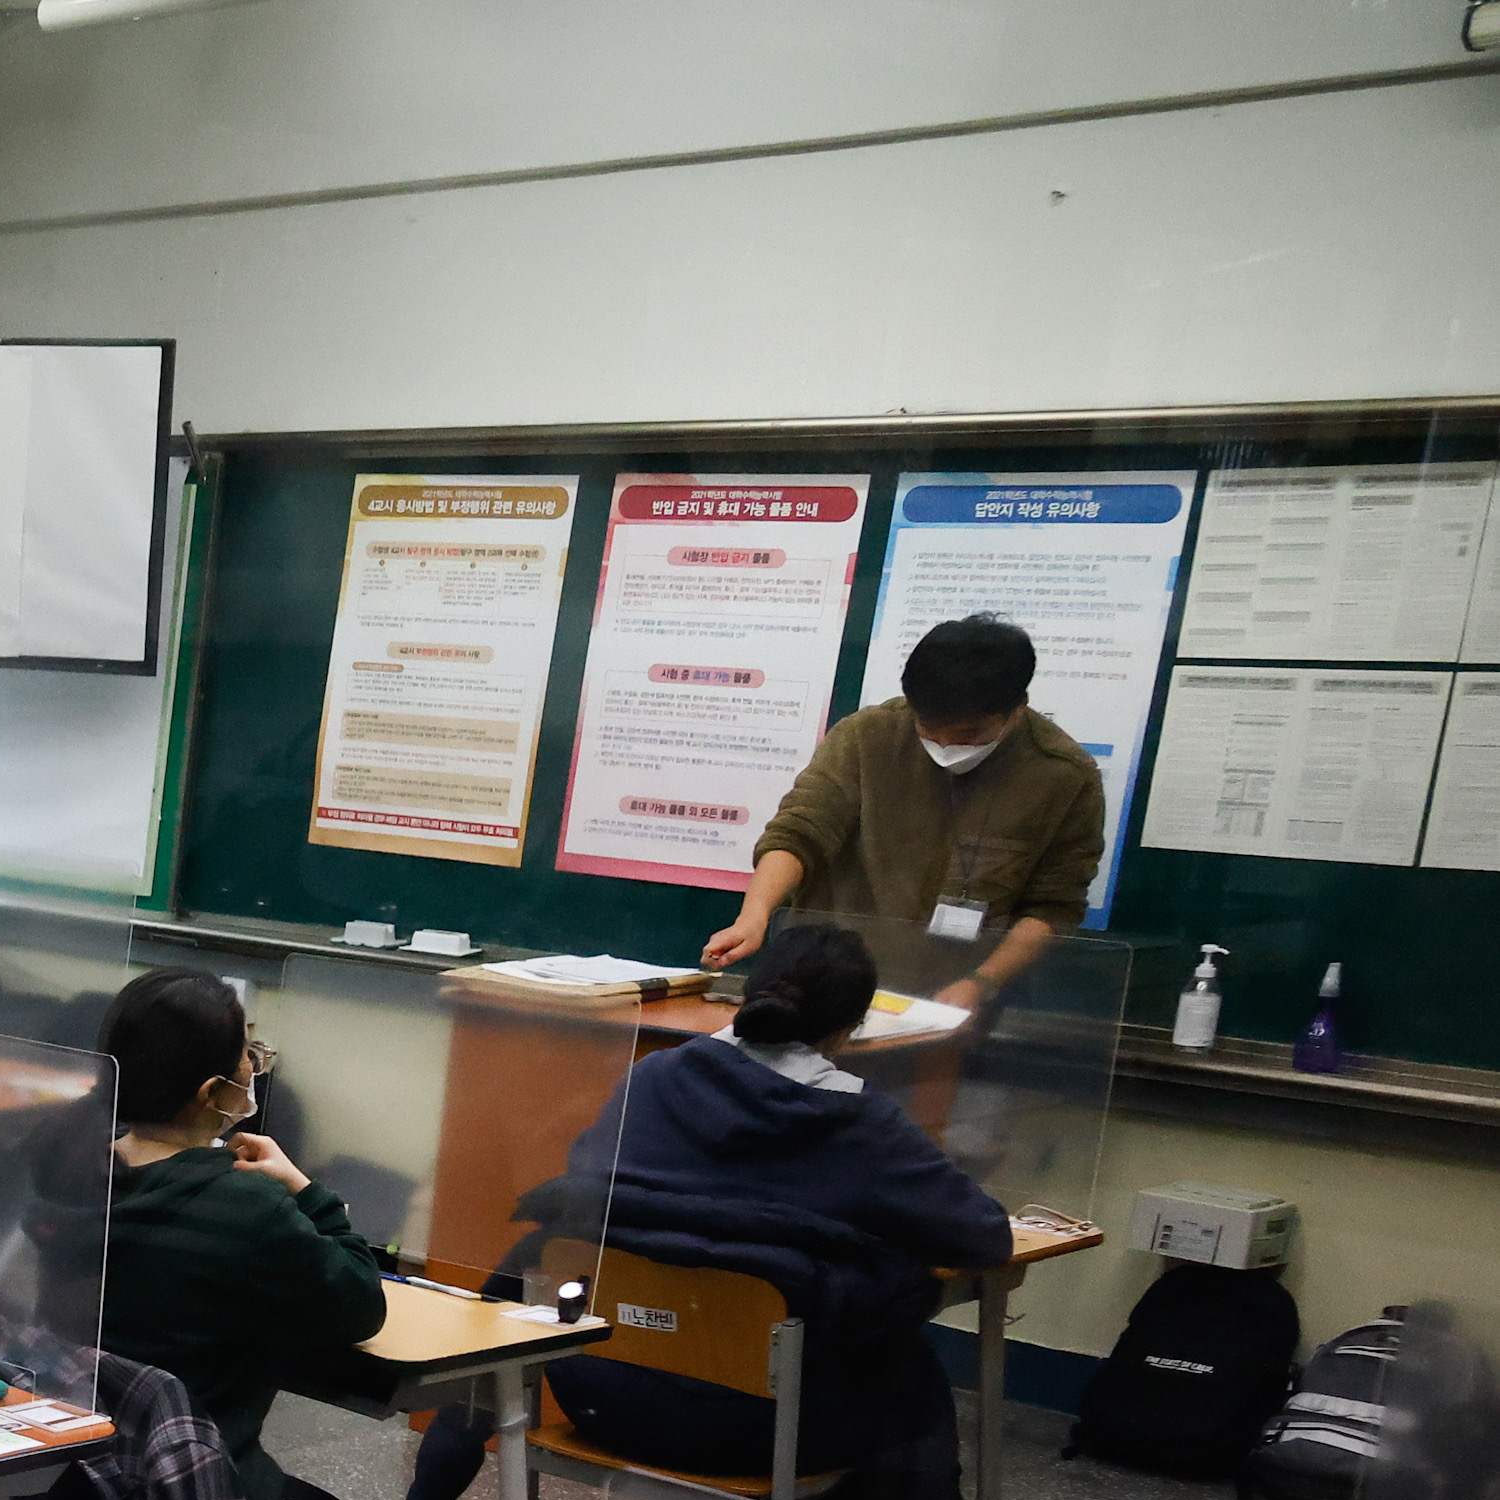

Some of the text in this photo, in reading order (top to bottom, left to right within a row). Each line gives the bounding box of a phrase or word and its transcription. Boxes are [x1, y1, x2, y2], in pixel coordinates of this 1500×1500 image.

[368, 499, 393, 512] 4교시
[396, 499, 435, 514] 응시방법
[437, 500, 448, 513] 및
[492, 500, 511, 515] 관련
[515, 500, 556, 516] 유의사항
[652, 501, 674, 515] 반입
[676, 501, 700, 516] 금지
[702, 502, 715, 516] 및
[716, 502, 740, 516] 휴대
[742, 502, 766, 516] 가능
[795, 503, 819, 517] 안내
[974, 502, 1102, 518] 답안지 작성 유의사항
[682, 552, 709, 563] 시험장
[711, 553, 729, 563] 반입
[731, 553, 750, 564] 금지
